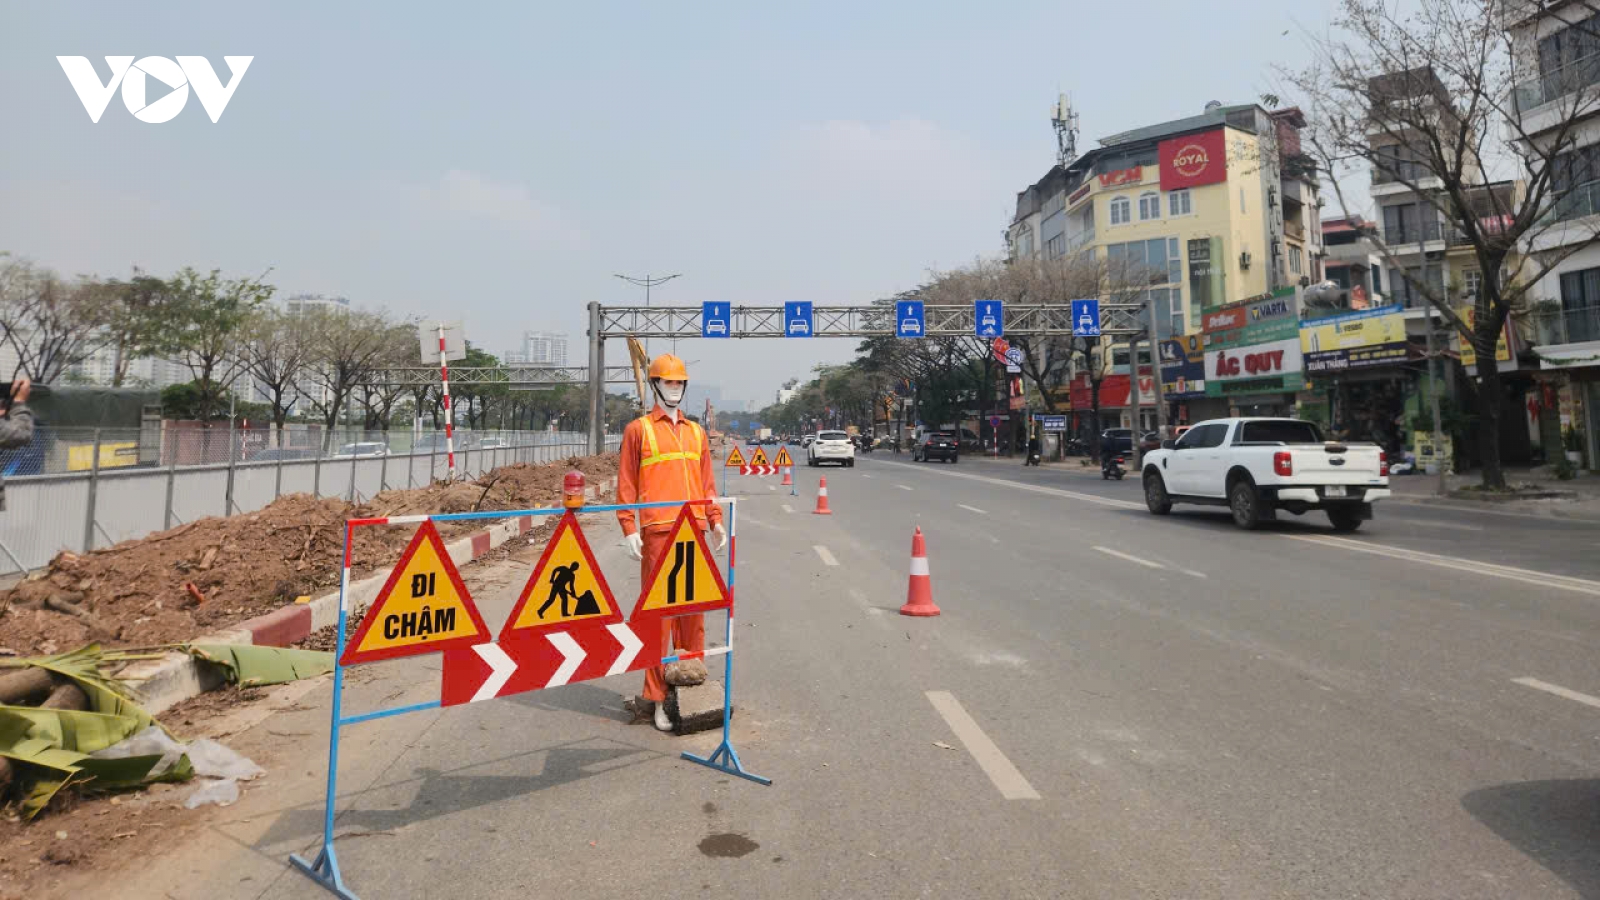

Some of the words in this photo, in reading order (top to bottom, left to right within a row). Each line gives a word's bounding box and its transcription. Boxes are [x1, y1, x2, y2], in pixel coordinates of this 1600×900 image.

[1173, 154, 1210, 168] ROYAL
[1259, 300, 1288, 317] VARTA
[1244, 349, 1285, 375] QUY
[411, 573, 435, 597] ĐI
[384, 606, 455, 639] CHẬM
